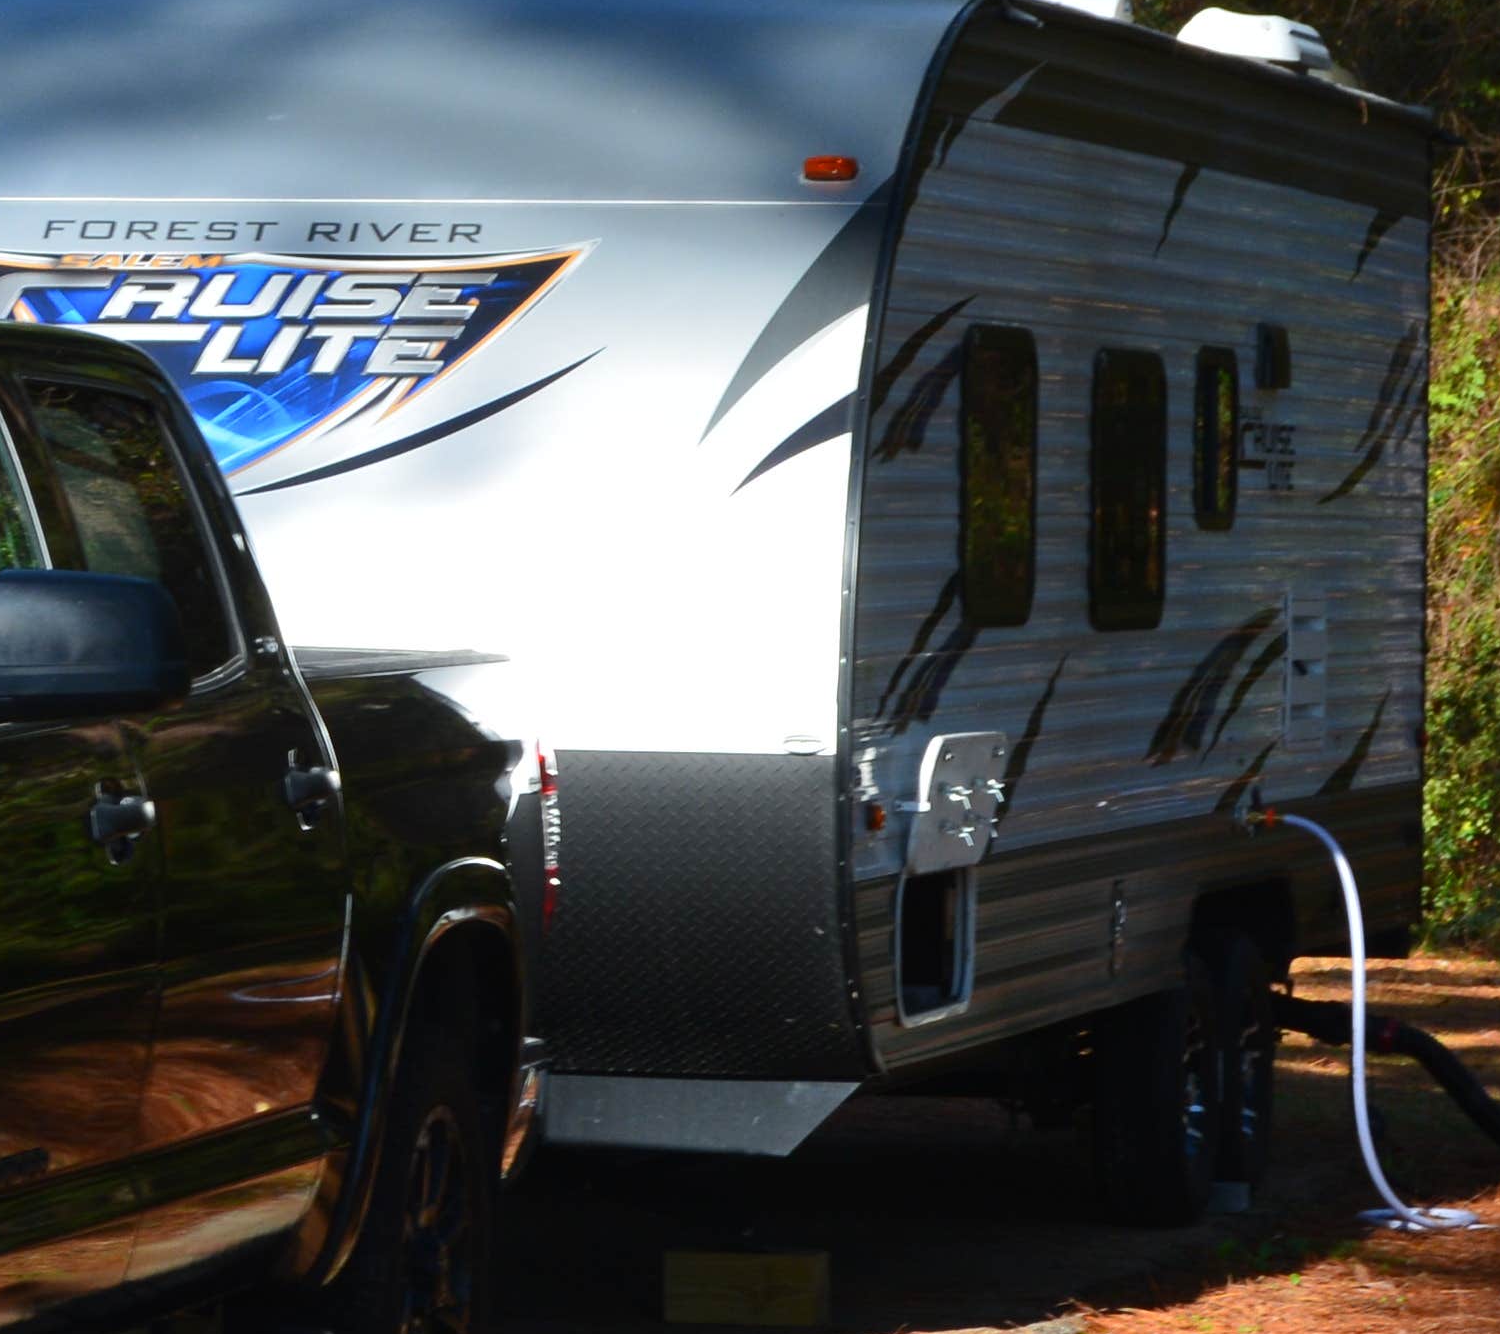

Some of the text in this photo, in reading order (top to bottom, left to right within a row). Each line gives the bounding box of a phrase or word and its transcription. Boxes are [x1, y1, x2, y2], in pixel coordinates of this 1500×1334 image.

[42, 219, 484, 243] FOREST RIVER
[60, 253, 223, 269] SALEM
[190, 324, 467, 376] LITE
